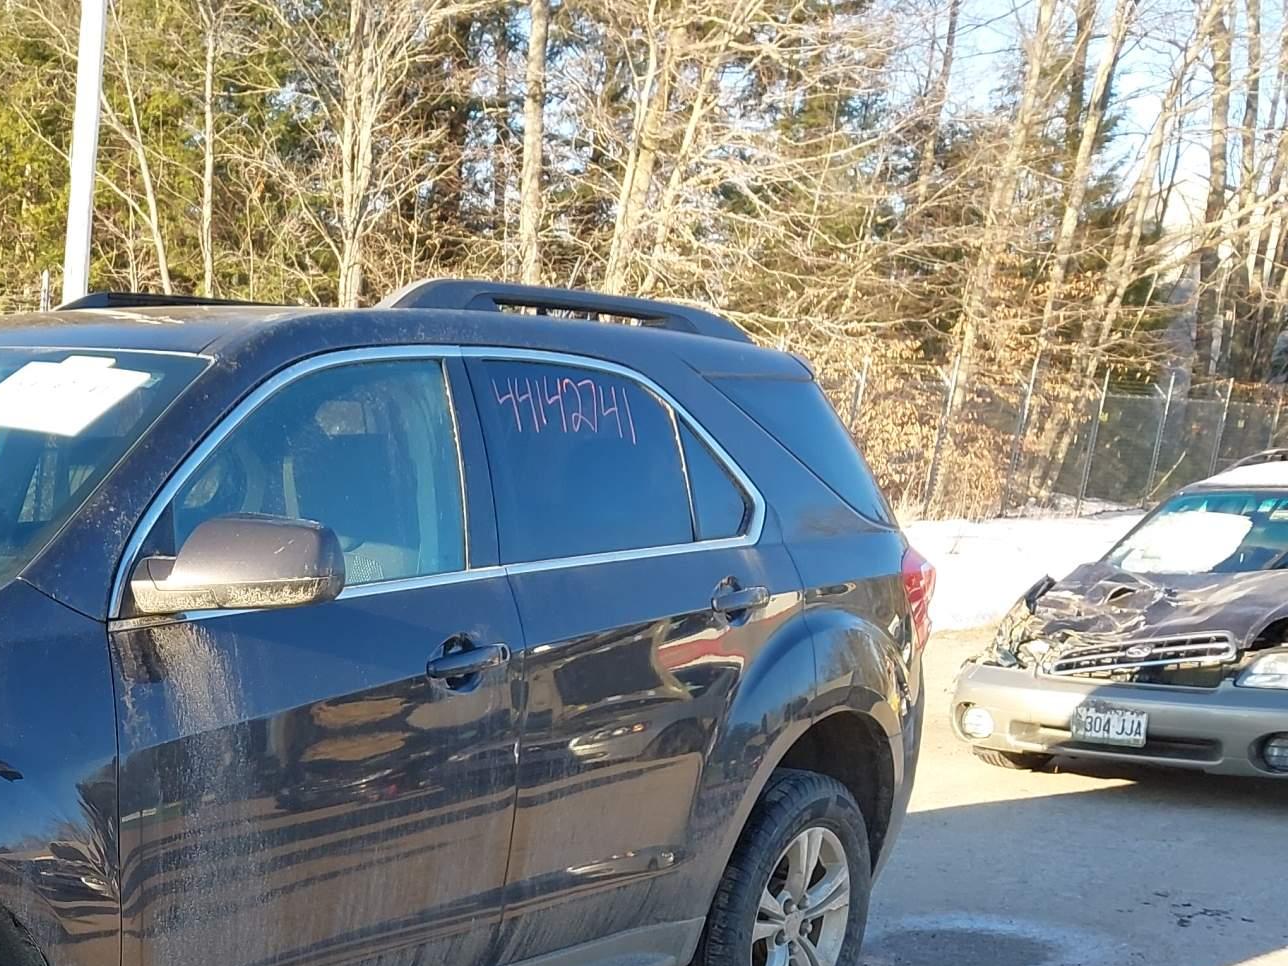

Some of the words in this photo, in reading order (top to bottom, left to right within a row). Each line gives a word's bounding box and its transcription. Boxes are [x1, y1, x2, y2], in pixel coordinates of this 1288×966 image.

[491, 375, 637, 446] 44142741
[1085, 716, 1110, 734] 304
[1116, 719, 1141, 736] JJA
